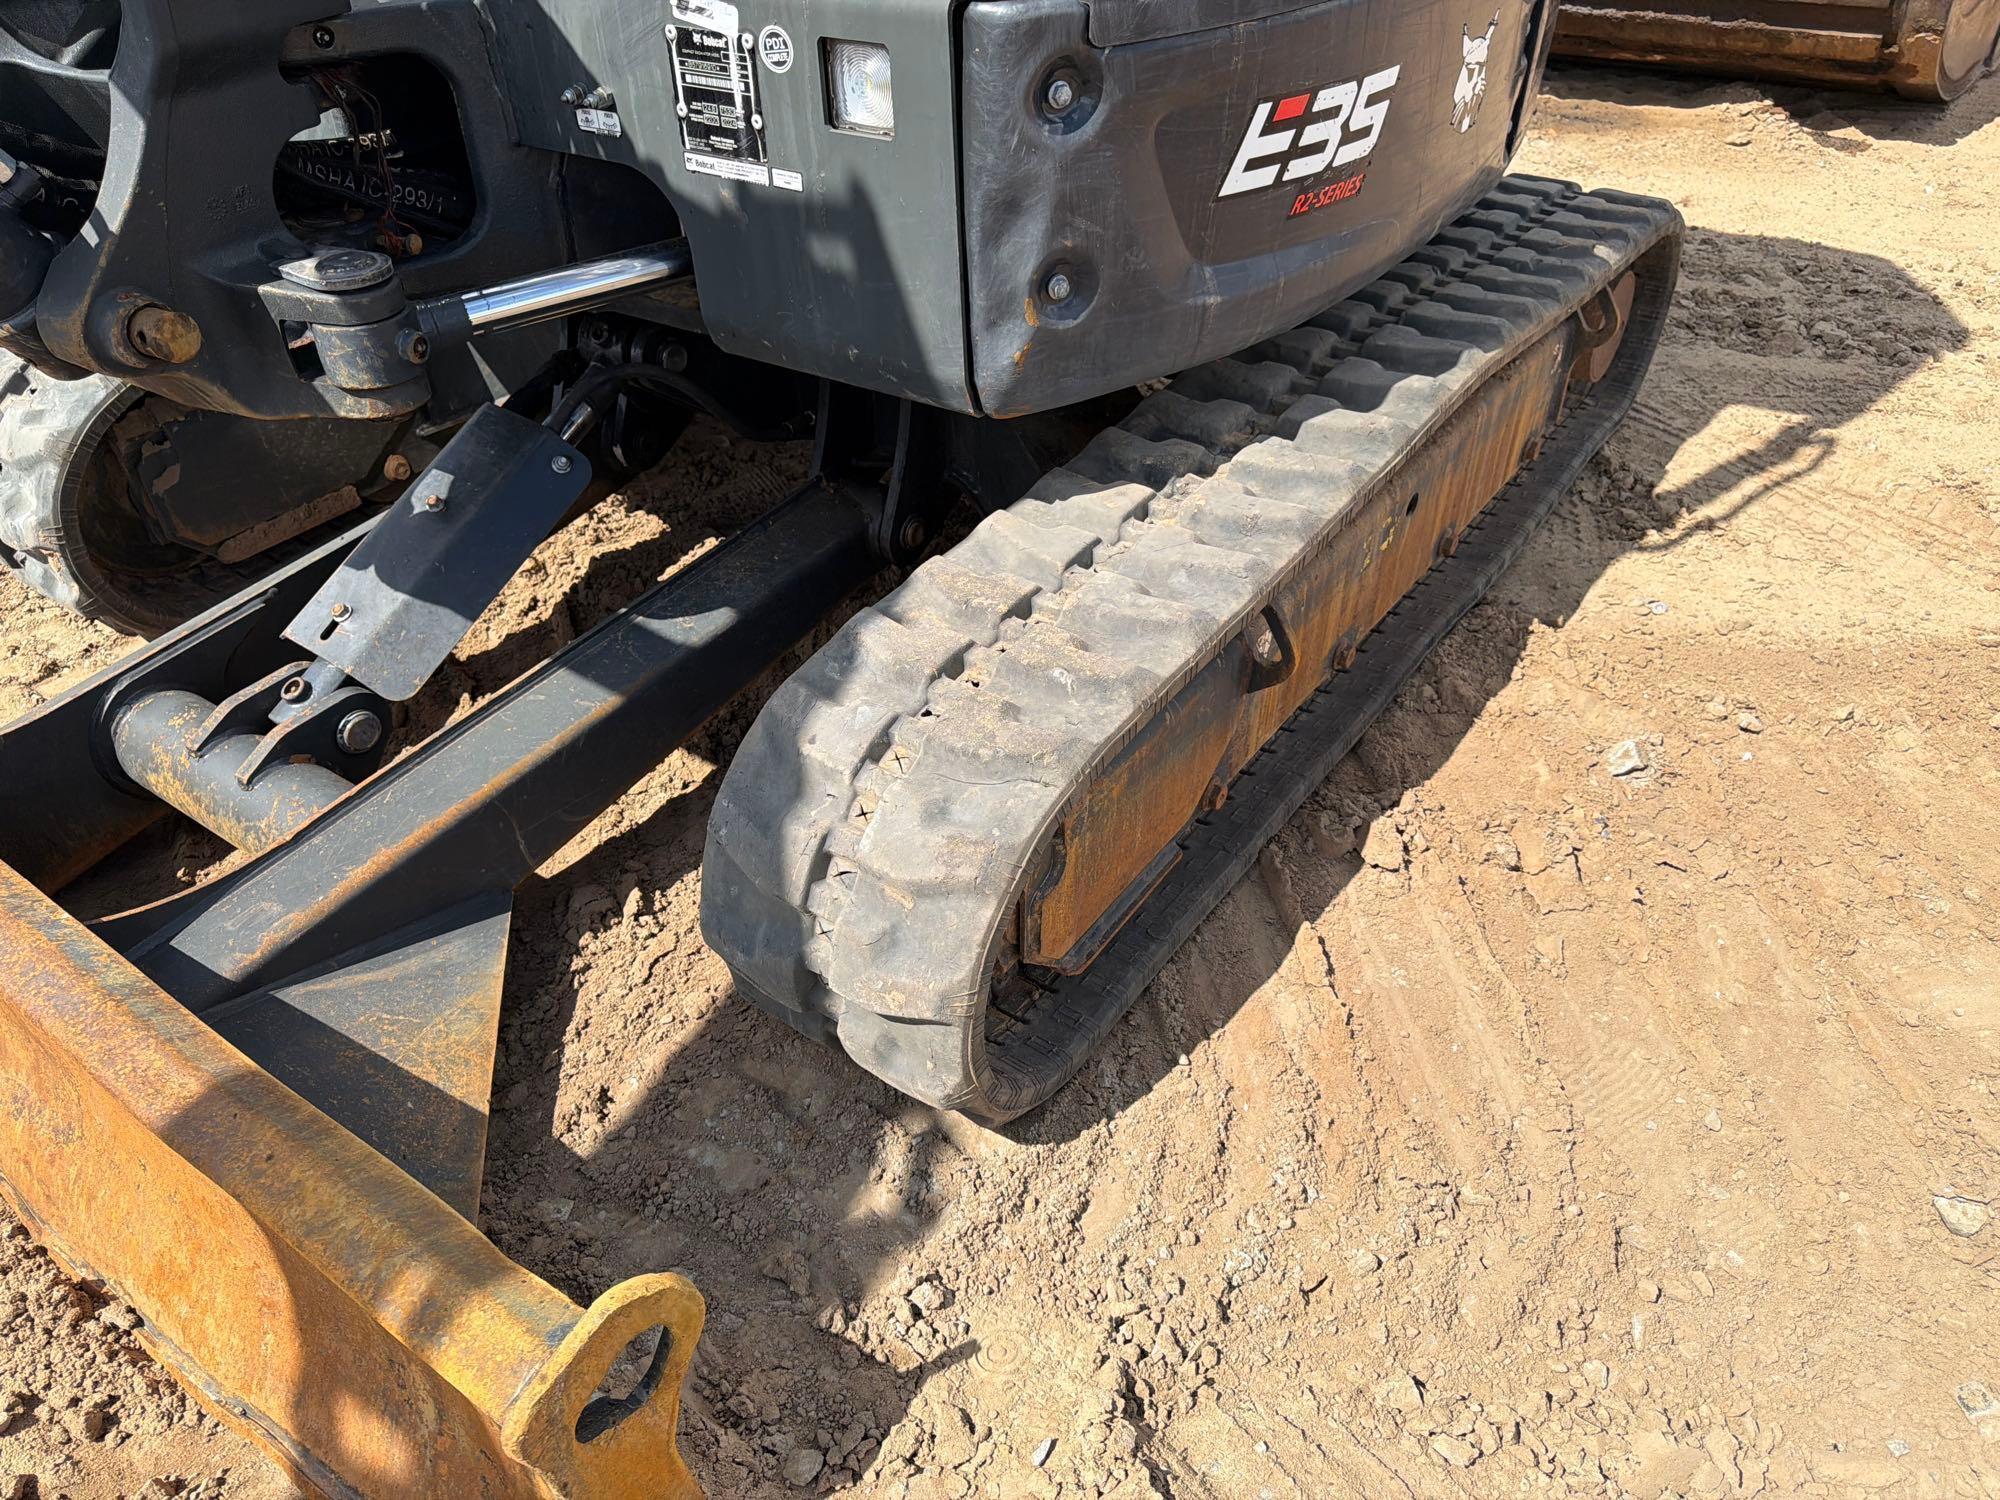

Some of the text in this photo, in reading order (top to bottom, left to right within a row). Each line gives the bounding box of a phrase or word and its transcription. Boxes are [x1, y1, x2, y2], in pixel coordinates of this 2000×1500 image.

[702, 35, 727, 48] Bobcat
[765, 37, 786, 51] PDI
[766, 52, 790, 62] COMPLETE
[1217, 64, 1401, 198] E35
[1289, 172, 1365, 216] R2-SERIES
